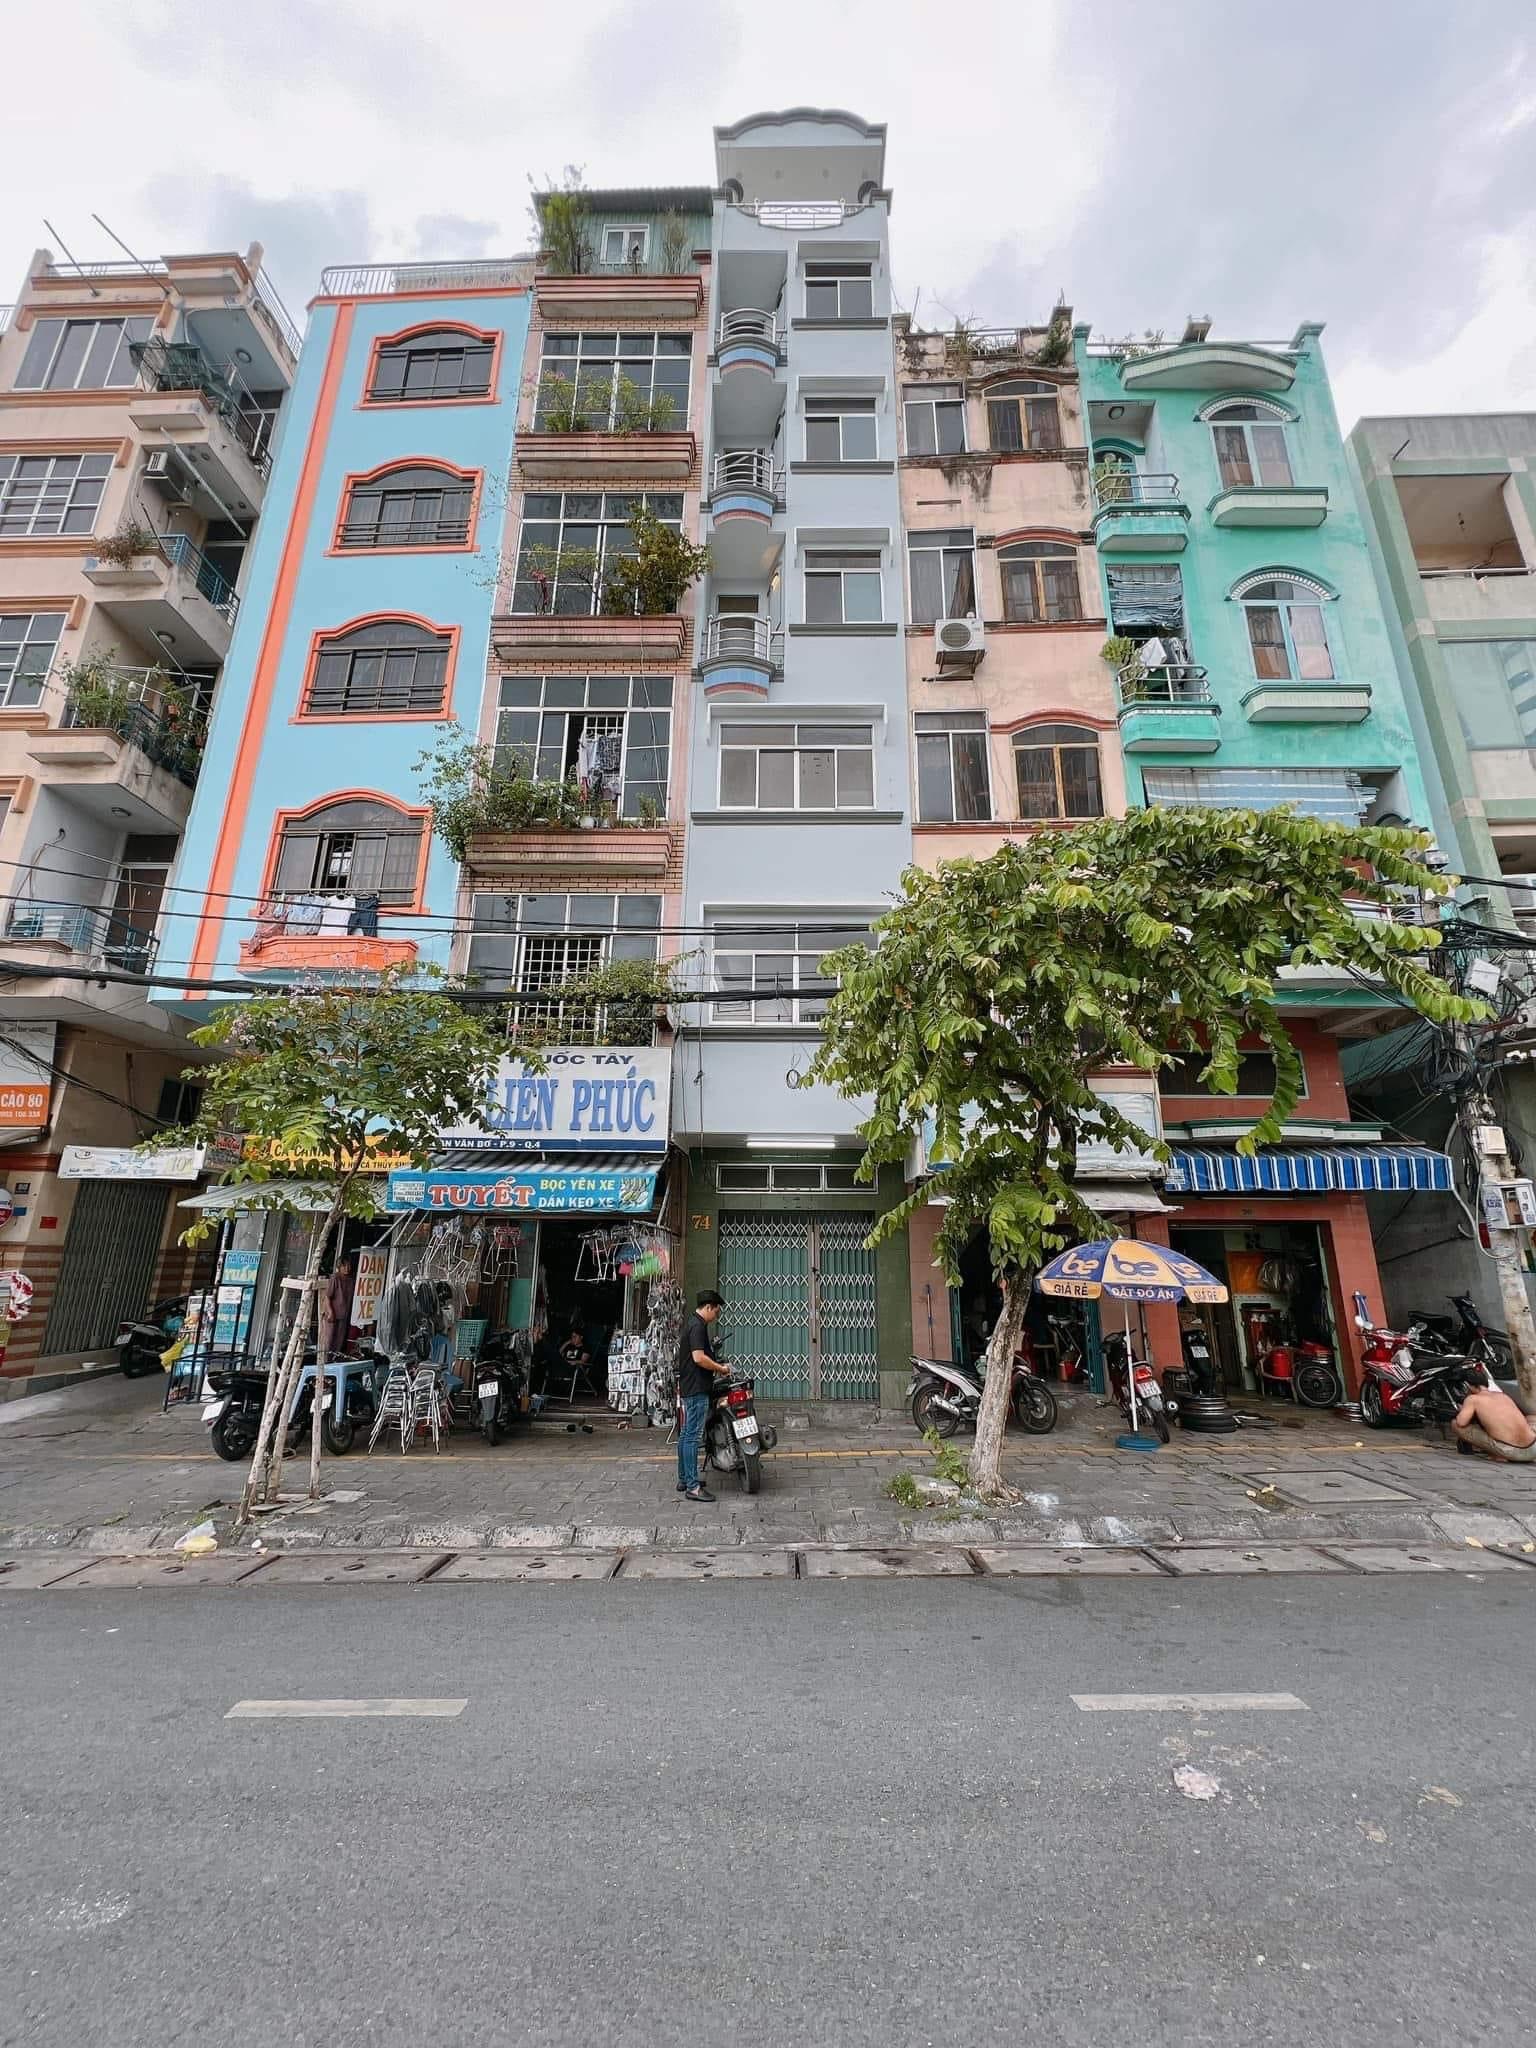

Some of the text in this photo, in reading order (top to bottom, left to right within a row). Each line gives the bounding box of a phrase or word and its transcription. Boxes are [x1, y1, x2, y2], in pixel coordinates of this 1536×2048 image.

[592, 1052, 634, 1065] TÂY
[27, 1093, 43, 1108] 80
[569, 1065, 656, 1132] PHÚC
[454, 1138, 475, 1148] VĂN
[524, 1139, 540, 1150] Q.4
[427, 1176, 536, 1207] TUYẾT
[540, 1179, 567, 1193] BỌC
[571, 1177, 596, 1190] YÊN
[599, 1179, 616, 1190] XE
[538, 1194, 565, 1208] DÁN
[598, 1197, 614, 1208] XE
[691, 1215, 710, 1230] 74
[1061, 1252, 1100, 1275] be
[1111, 1254, 1159, 1277] be
[357, 1277, 382, 1297] KEO
[358, 1300, 374, 1319] XE
